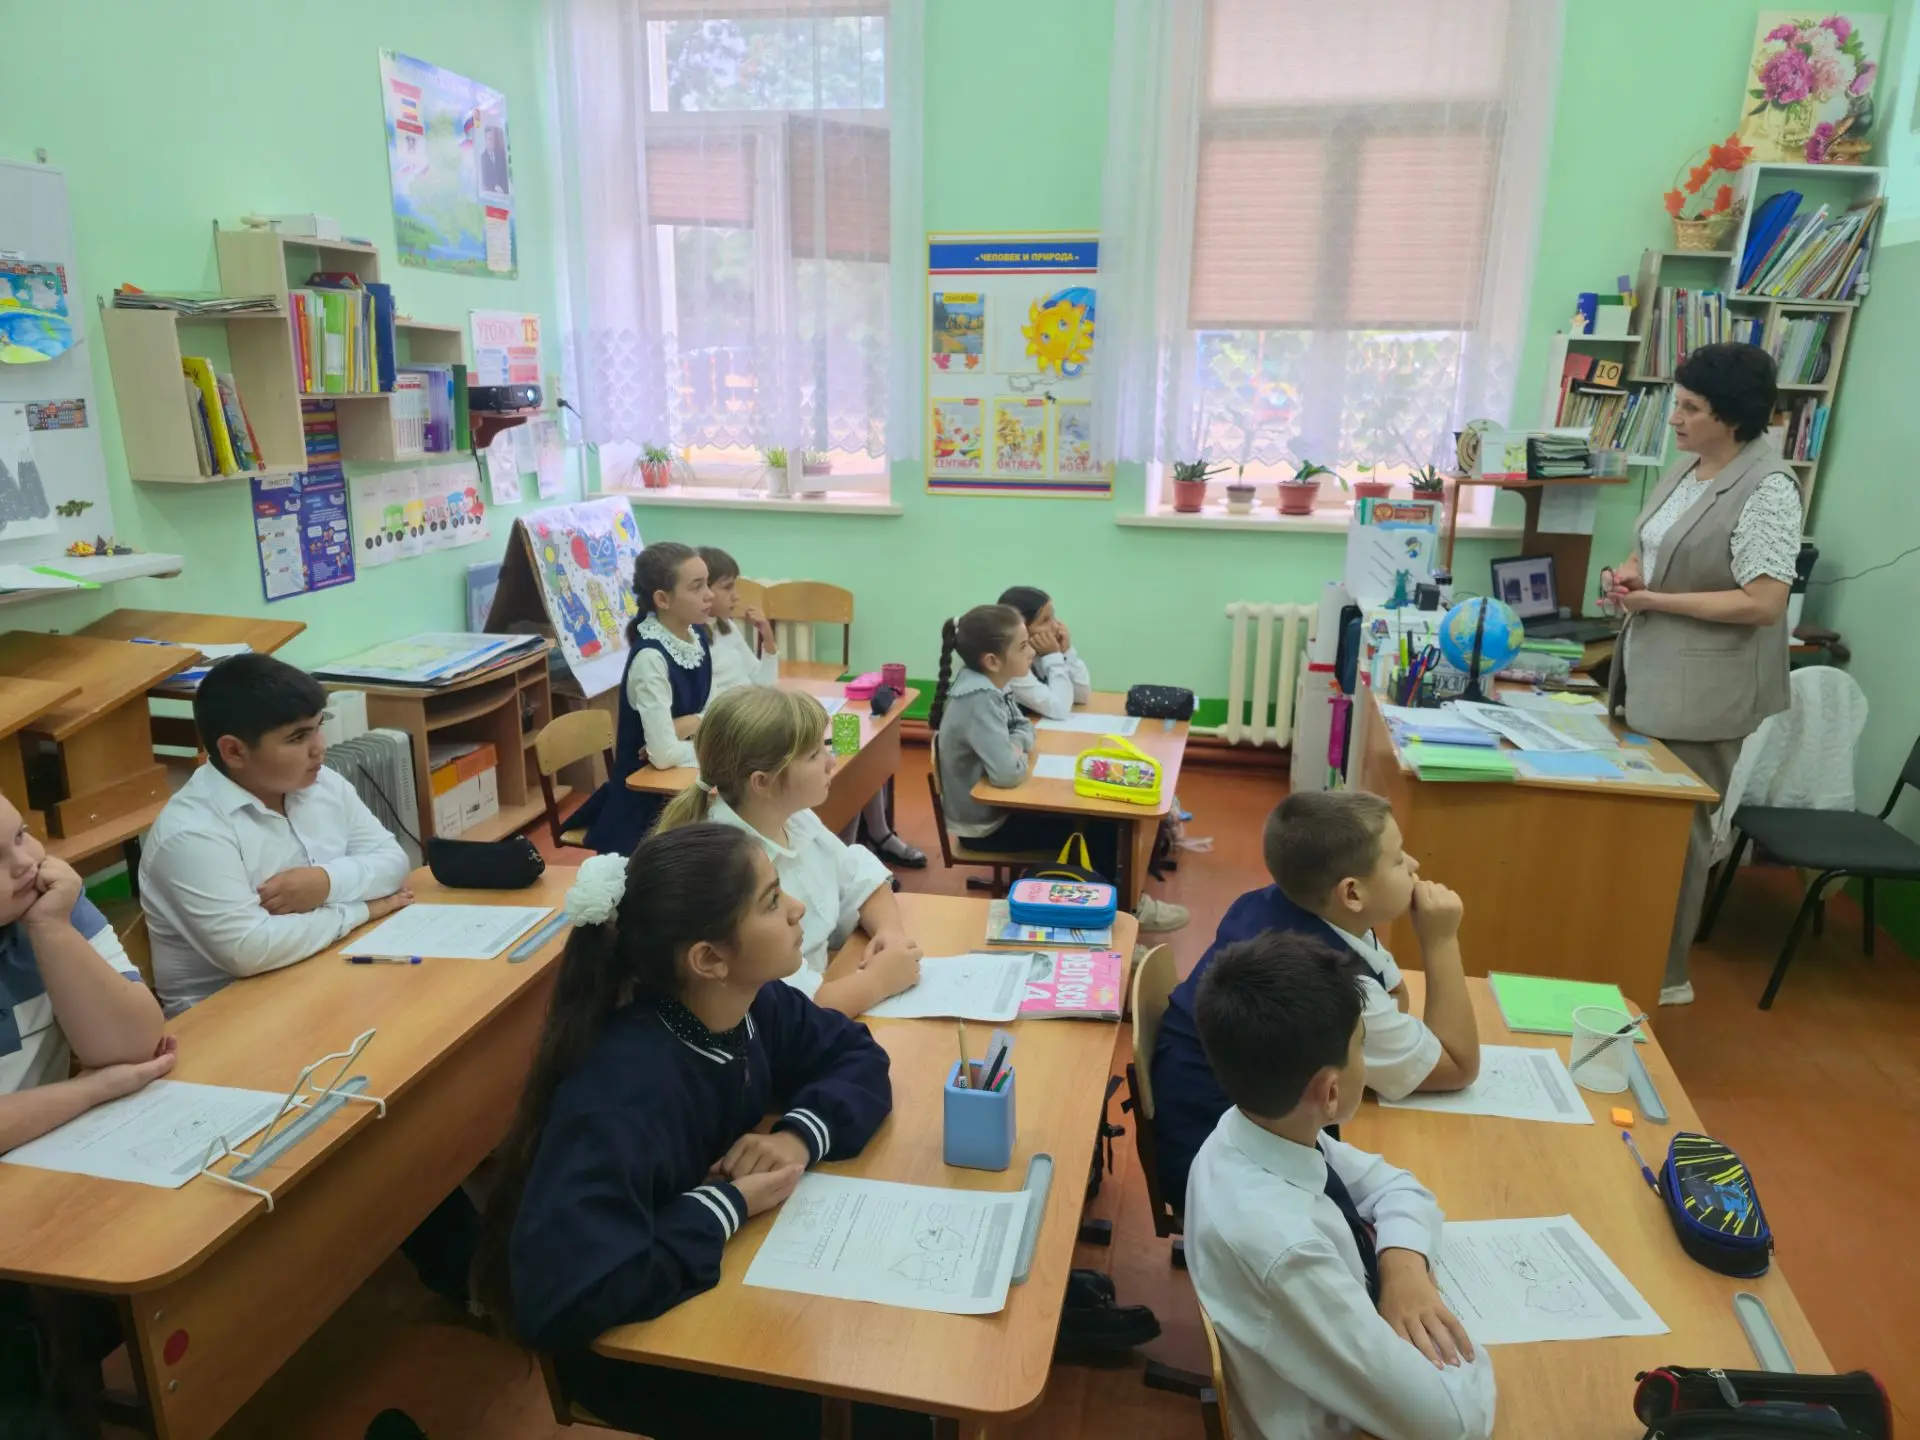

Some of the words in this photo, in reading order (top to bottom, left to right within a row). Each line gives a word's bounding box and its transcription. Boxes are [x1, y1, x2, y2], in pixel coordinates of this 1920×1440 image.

[1022, 252, 1030, 262] И
[1596, 364, 1619, 380] 10
[996, 457, 1043, 471] ОКТЯБРЬ
[1055, 952, 1095, 1008] DEUTSCH
